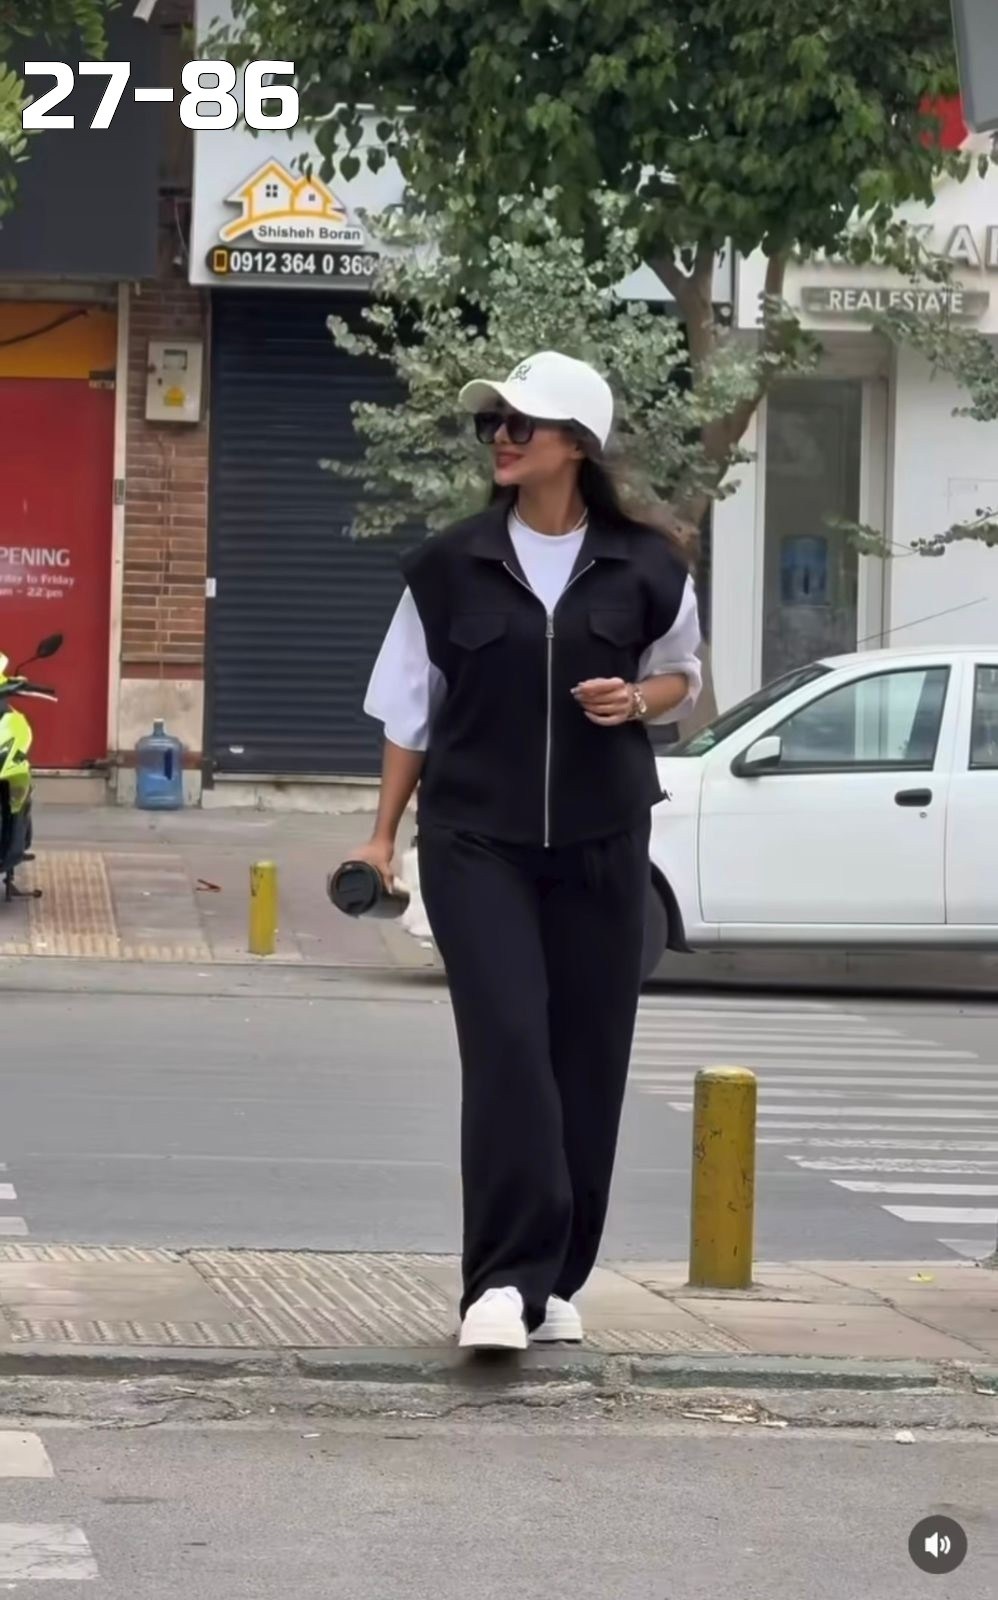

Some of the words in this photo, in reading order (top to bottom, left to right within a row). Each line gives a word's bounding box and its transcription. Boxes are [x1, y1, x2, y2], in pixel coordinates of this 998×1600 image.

[258, 225, 314, 238] Shisheh
[319, 227, 360, 240] Boran
[230, 251, 277, 272] 0912
[281, 253, 316, 274] 364
[322, 254, 334, 275] 0
[27, 574, 38, 583] to
[41, 574, 74, 588] Friday
